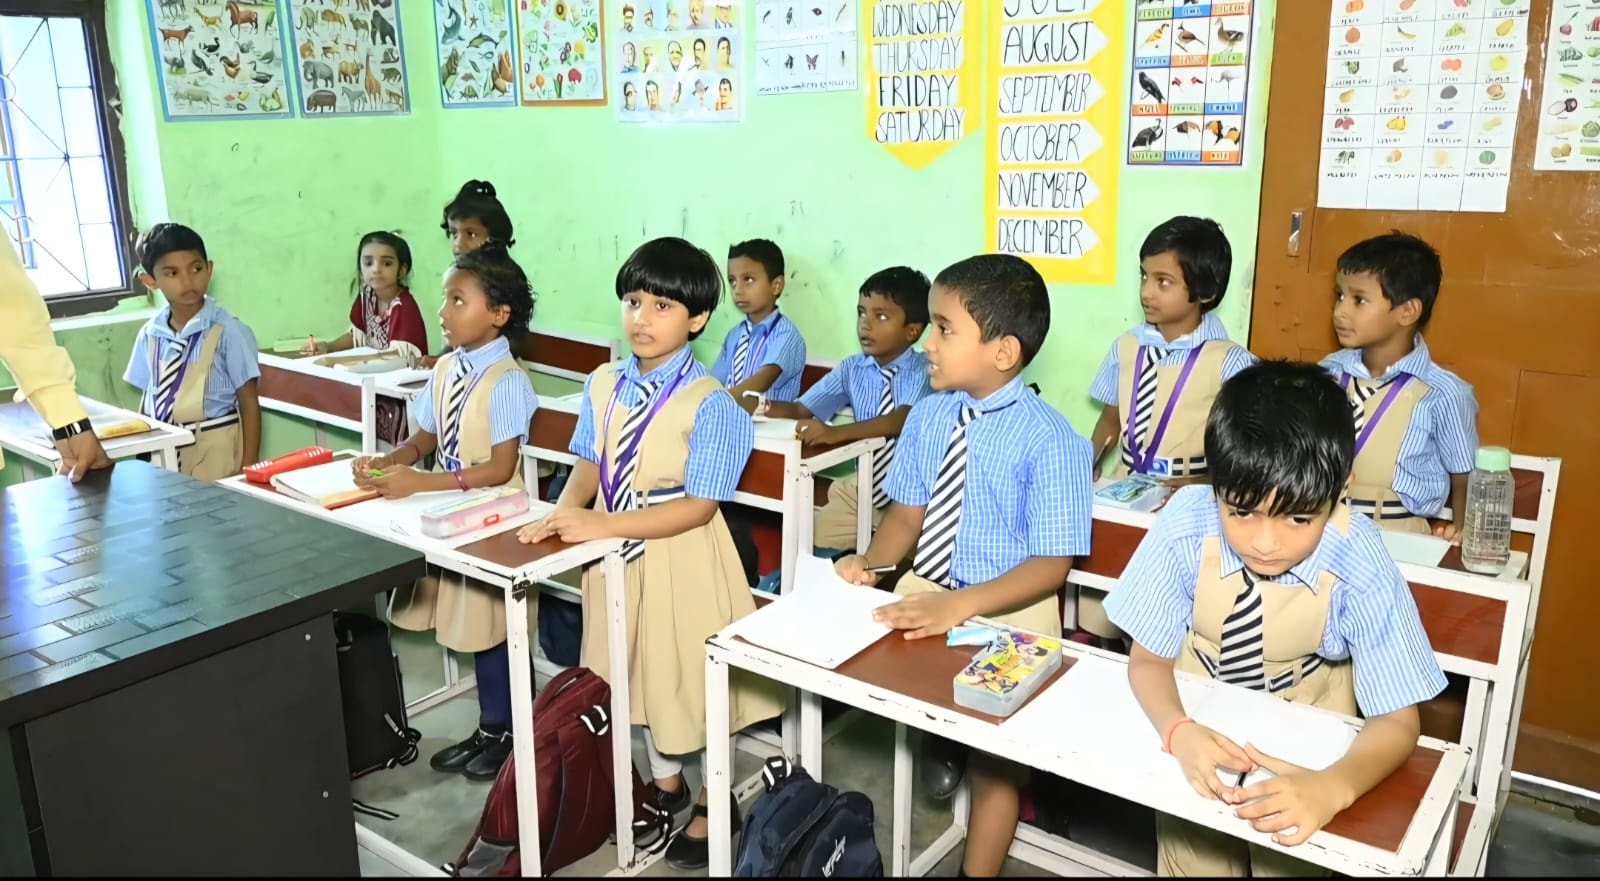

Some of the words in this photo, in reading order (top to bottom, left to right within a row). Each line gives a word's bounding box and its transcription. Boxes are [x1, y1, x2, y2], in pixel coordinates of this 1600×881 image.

[873, 0, 961, 37] WEDNESDAY
[873, 36, 961, 73] THURSDAY
[1004, 21, 1093, 64] AUGUST
[880, 74, 956, 106] FRIDAY
[999, 73, 1091, 113] SEPTEMBER
[875, 108, 964, 143] SATURDAY
[1001, 123, 1080, 161] OCTOBER
[999, 172, 1086, 208] NOVEMBER
[998, 219, 1083, 256] DECEMBER
